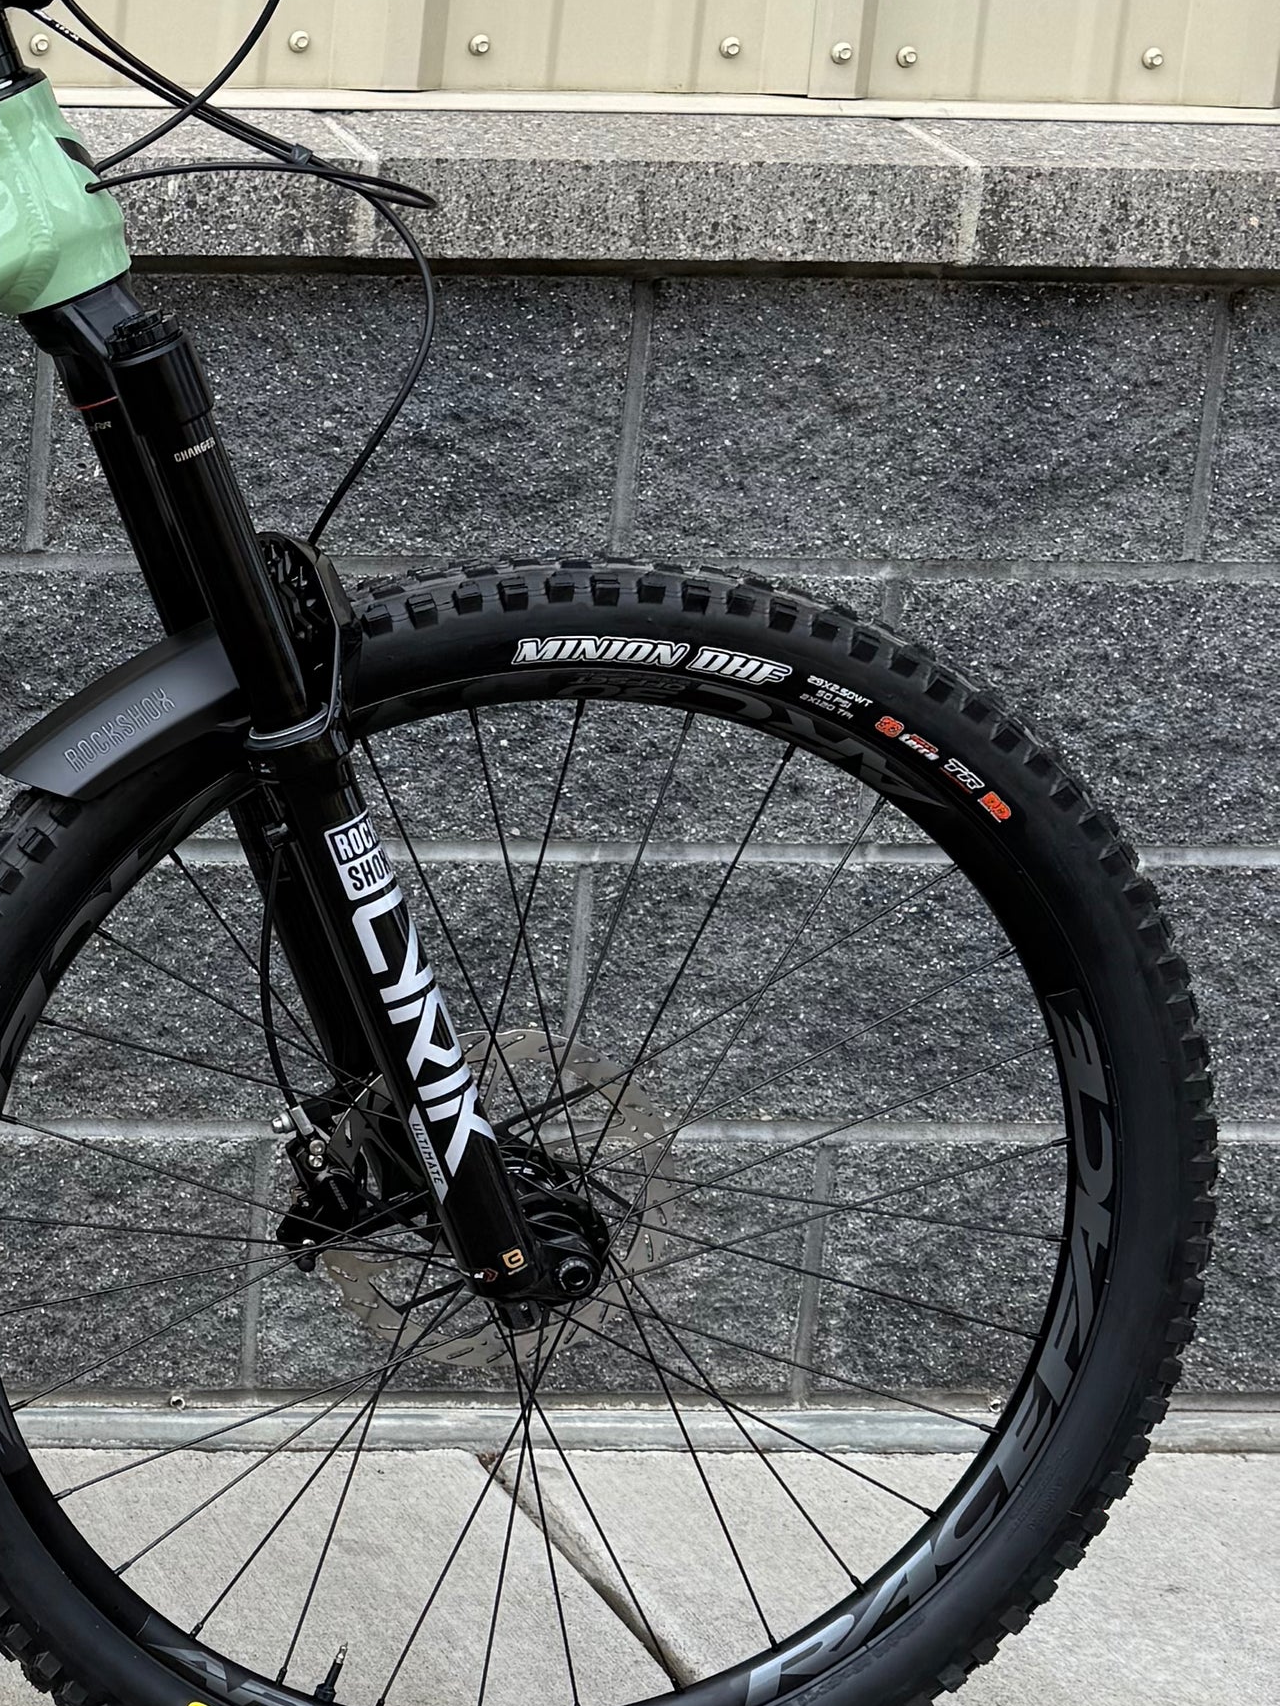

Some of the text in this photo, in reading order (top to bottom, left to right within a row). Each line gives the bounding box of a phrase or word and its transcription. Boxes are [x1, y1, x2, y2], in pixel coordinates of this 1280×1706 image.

[511, 636, 793, 685] MINION DHF
[63, 687, 176, 774] ROCKSHOX
[410, 1121, 445, 1187] ULTIMATE
